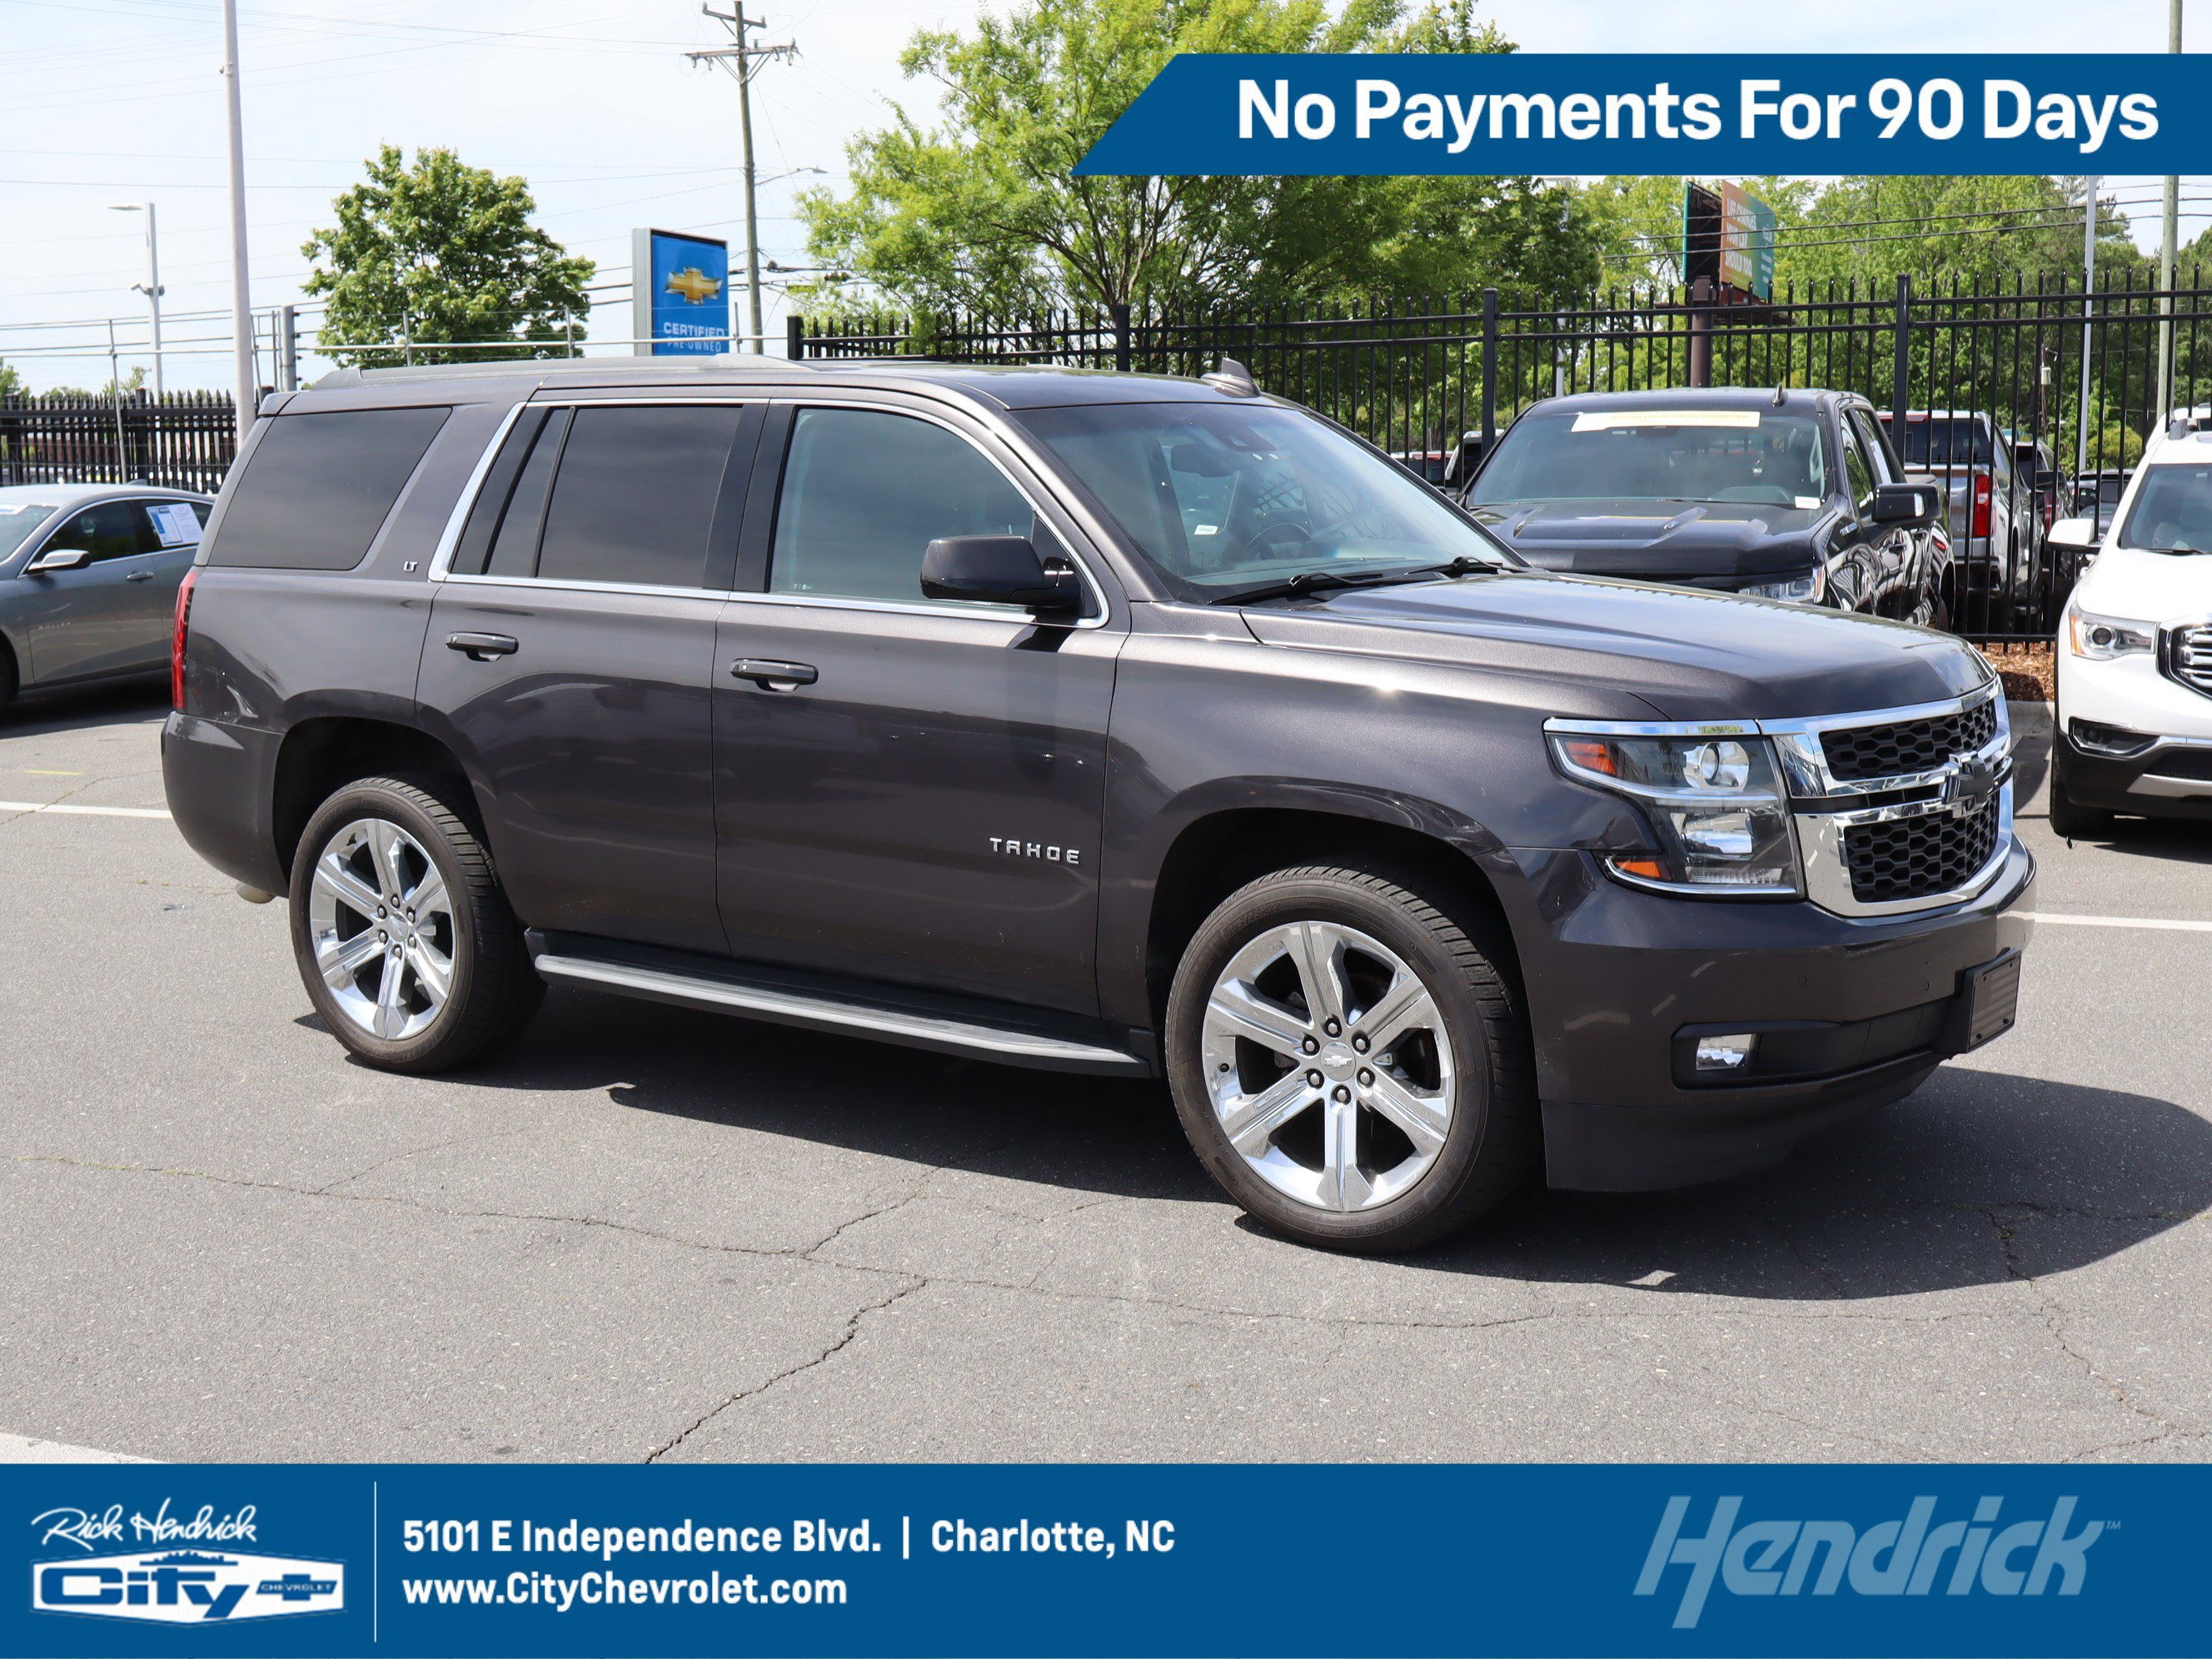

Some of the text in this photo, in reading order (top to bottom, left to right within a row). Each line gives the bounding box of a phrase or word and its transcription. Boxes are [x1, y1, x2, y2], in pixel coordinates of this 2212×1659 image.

[663, 321, 726, 337] CERTIFIED
[403, 560, 418, 572] LT
[989, 837, 1080, 864] TAHOE
